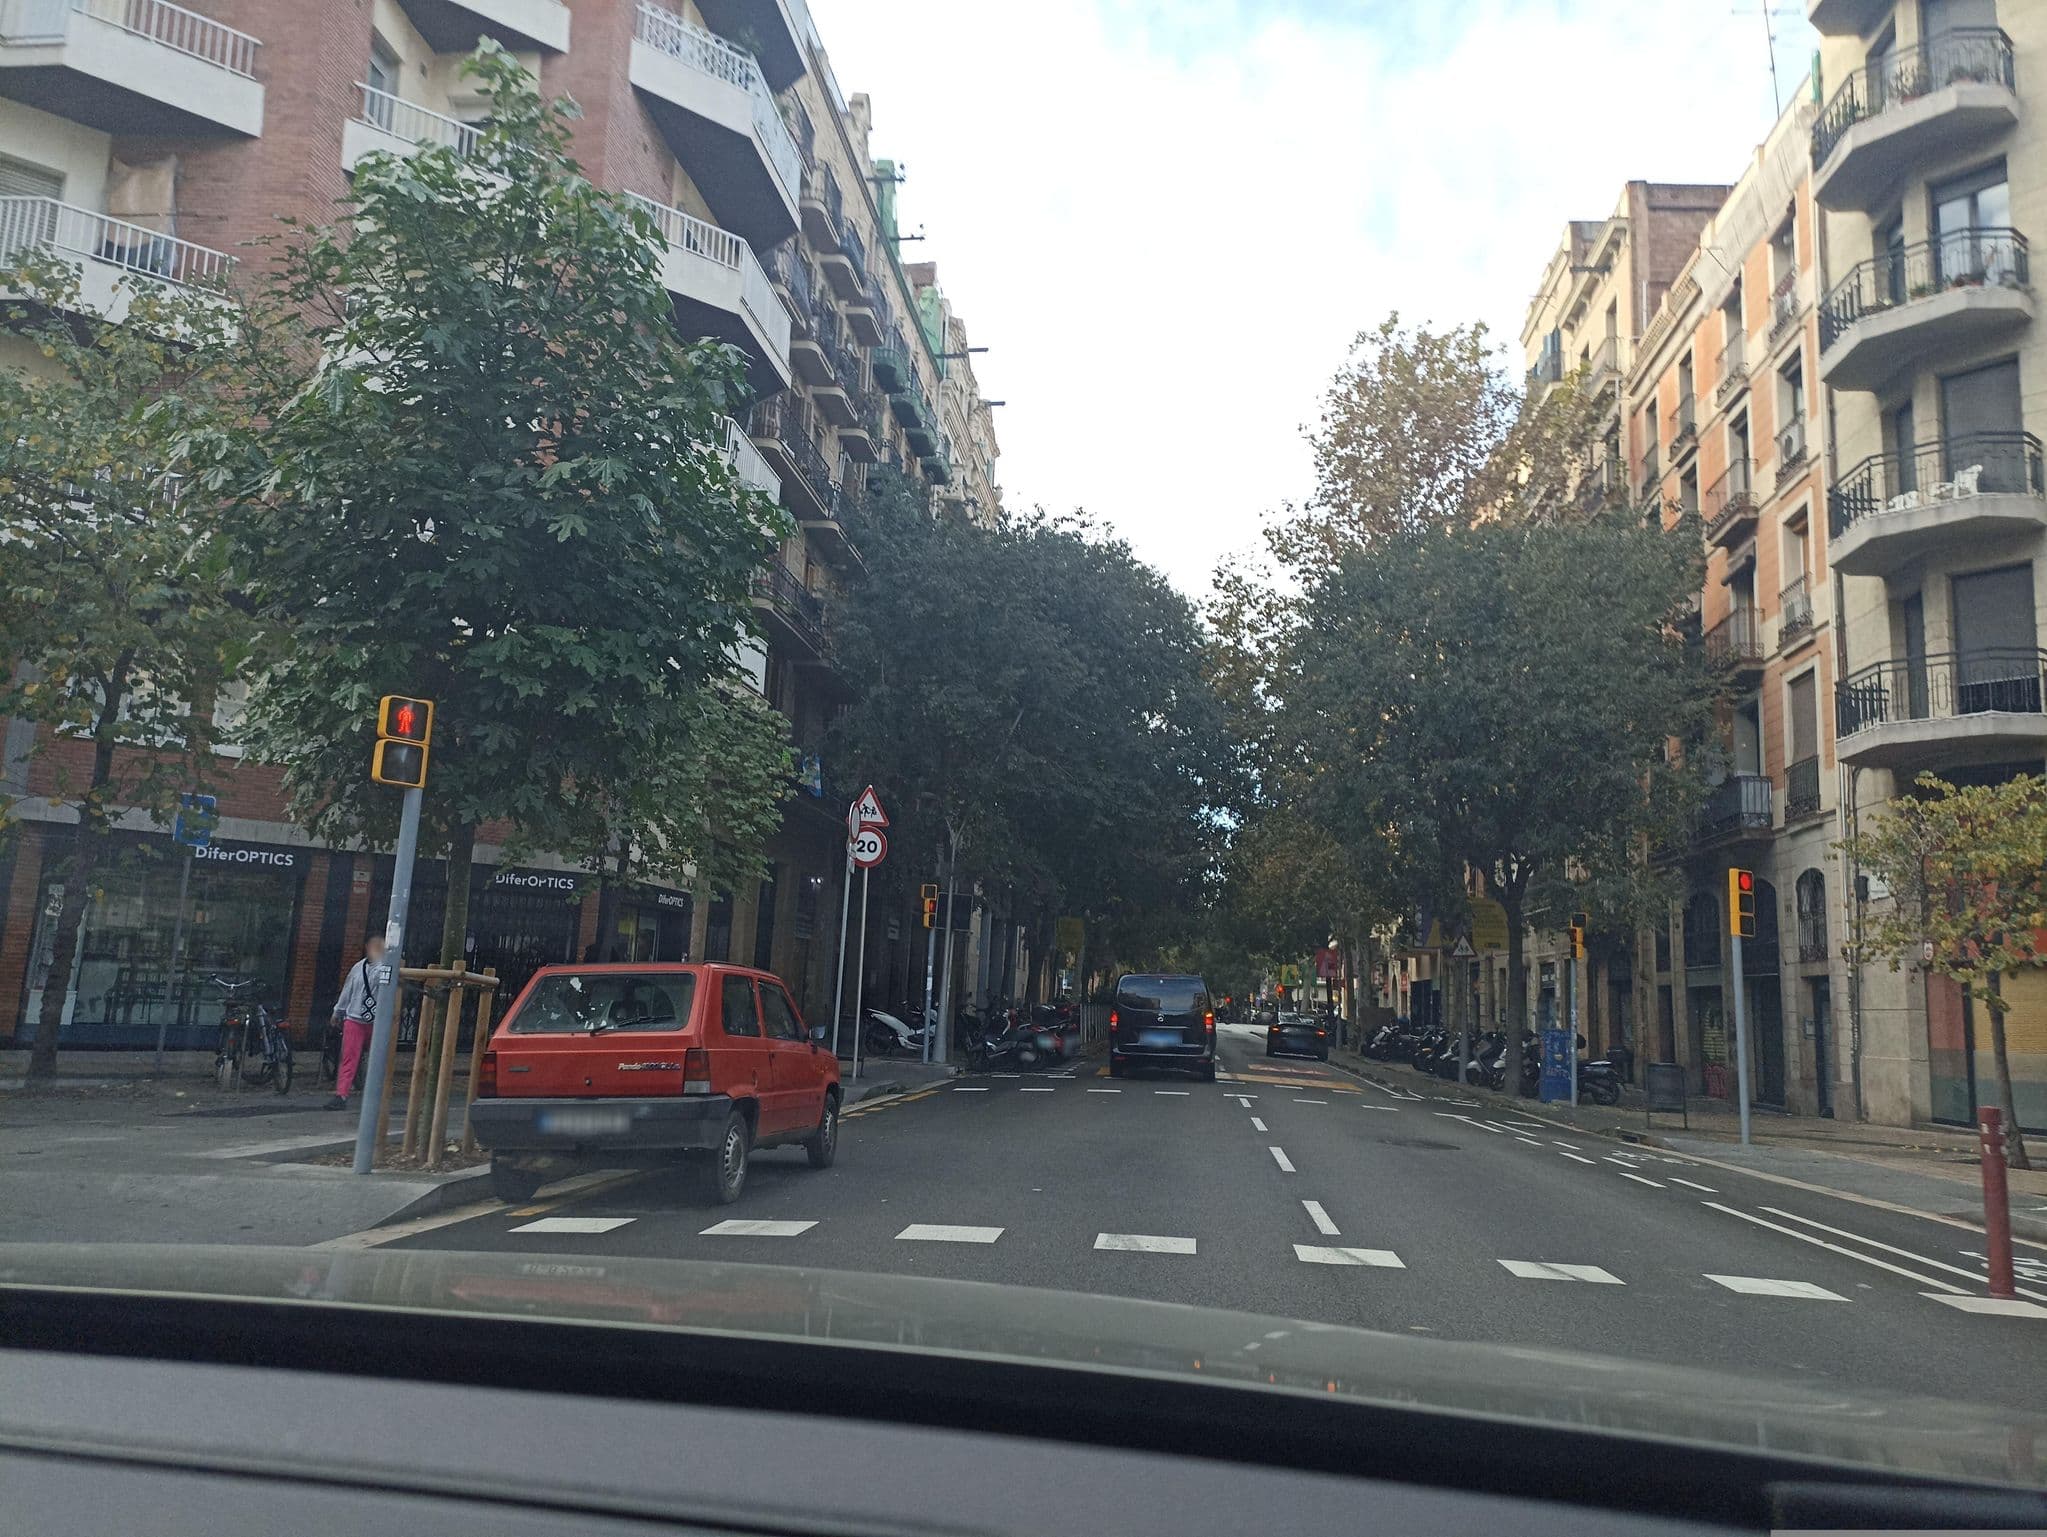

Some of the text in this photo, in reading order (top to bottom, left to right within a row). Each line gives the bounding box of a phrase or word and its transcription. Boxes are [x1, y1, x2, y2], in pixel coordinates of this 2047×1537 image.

[856, 840, 878, 854] 20
[195, 846, 294, 867] DiferOPTICS
[495, 873, 574, 890] DiferOPTICS
